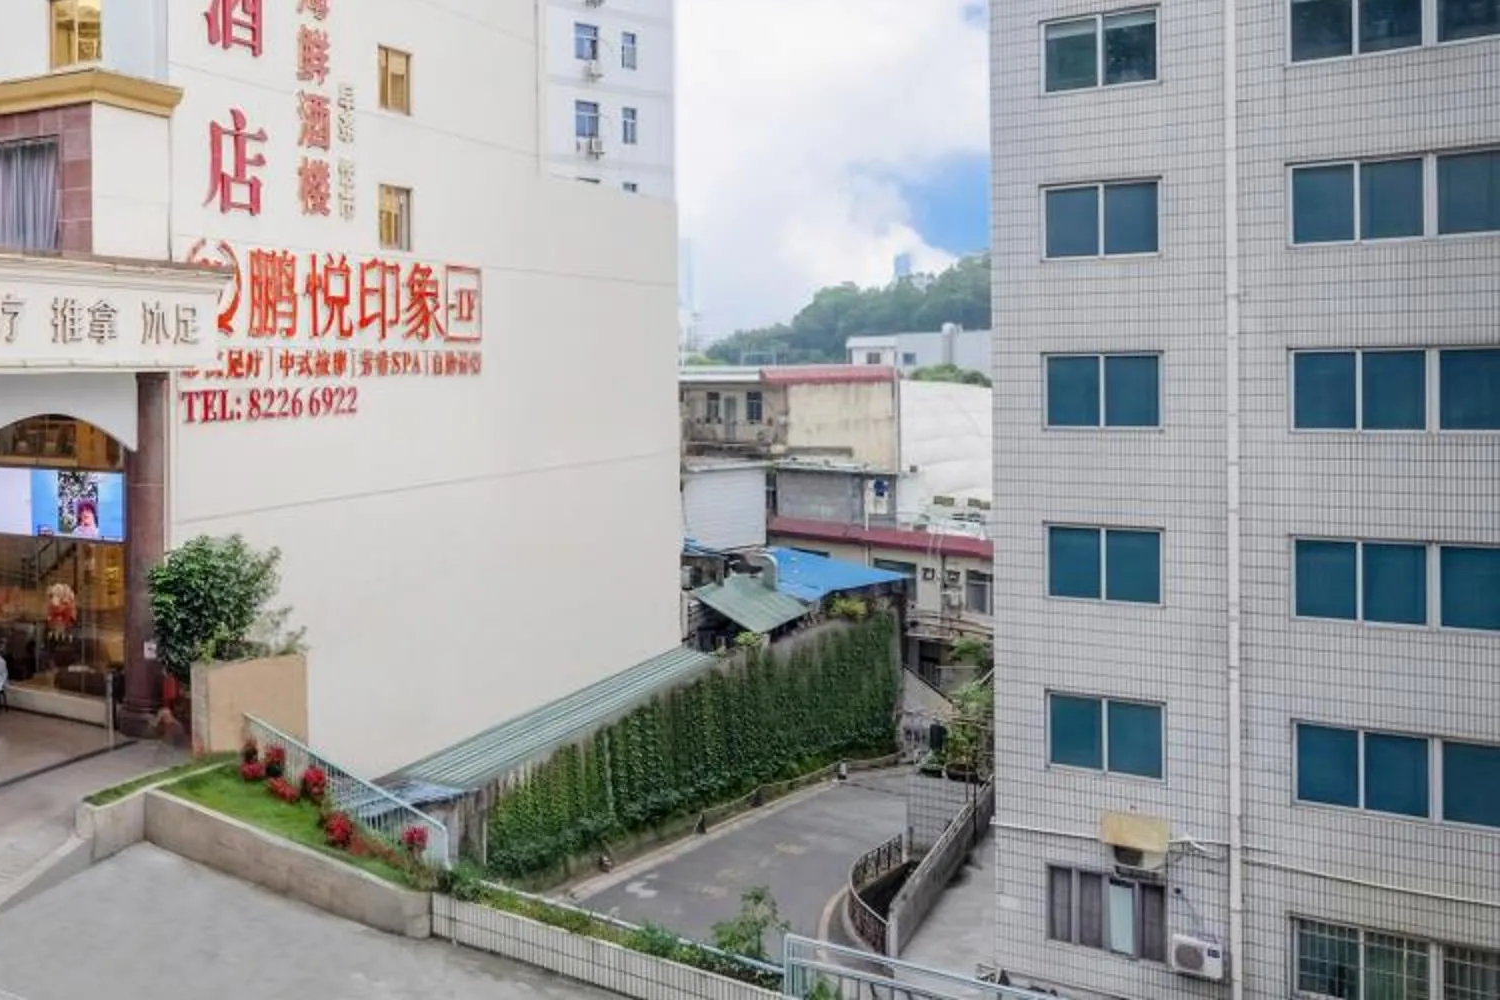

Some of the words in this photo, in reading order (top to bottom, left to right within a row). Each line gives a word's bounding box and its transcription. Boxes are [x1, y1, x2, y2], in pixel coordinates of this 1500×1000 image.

[247, 247, 446, 341] 鹏悦印象
[51, 297, 118, 345] 推拿
[181, 388, 242, 424] TEL:
[247, 387, 304, 421] 8226
[308, 386, 358, 416] 6922
